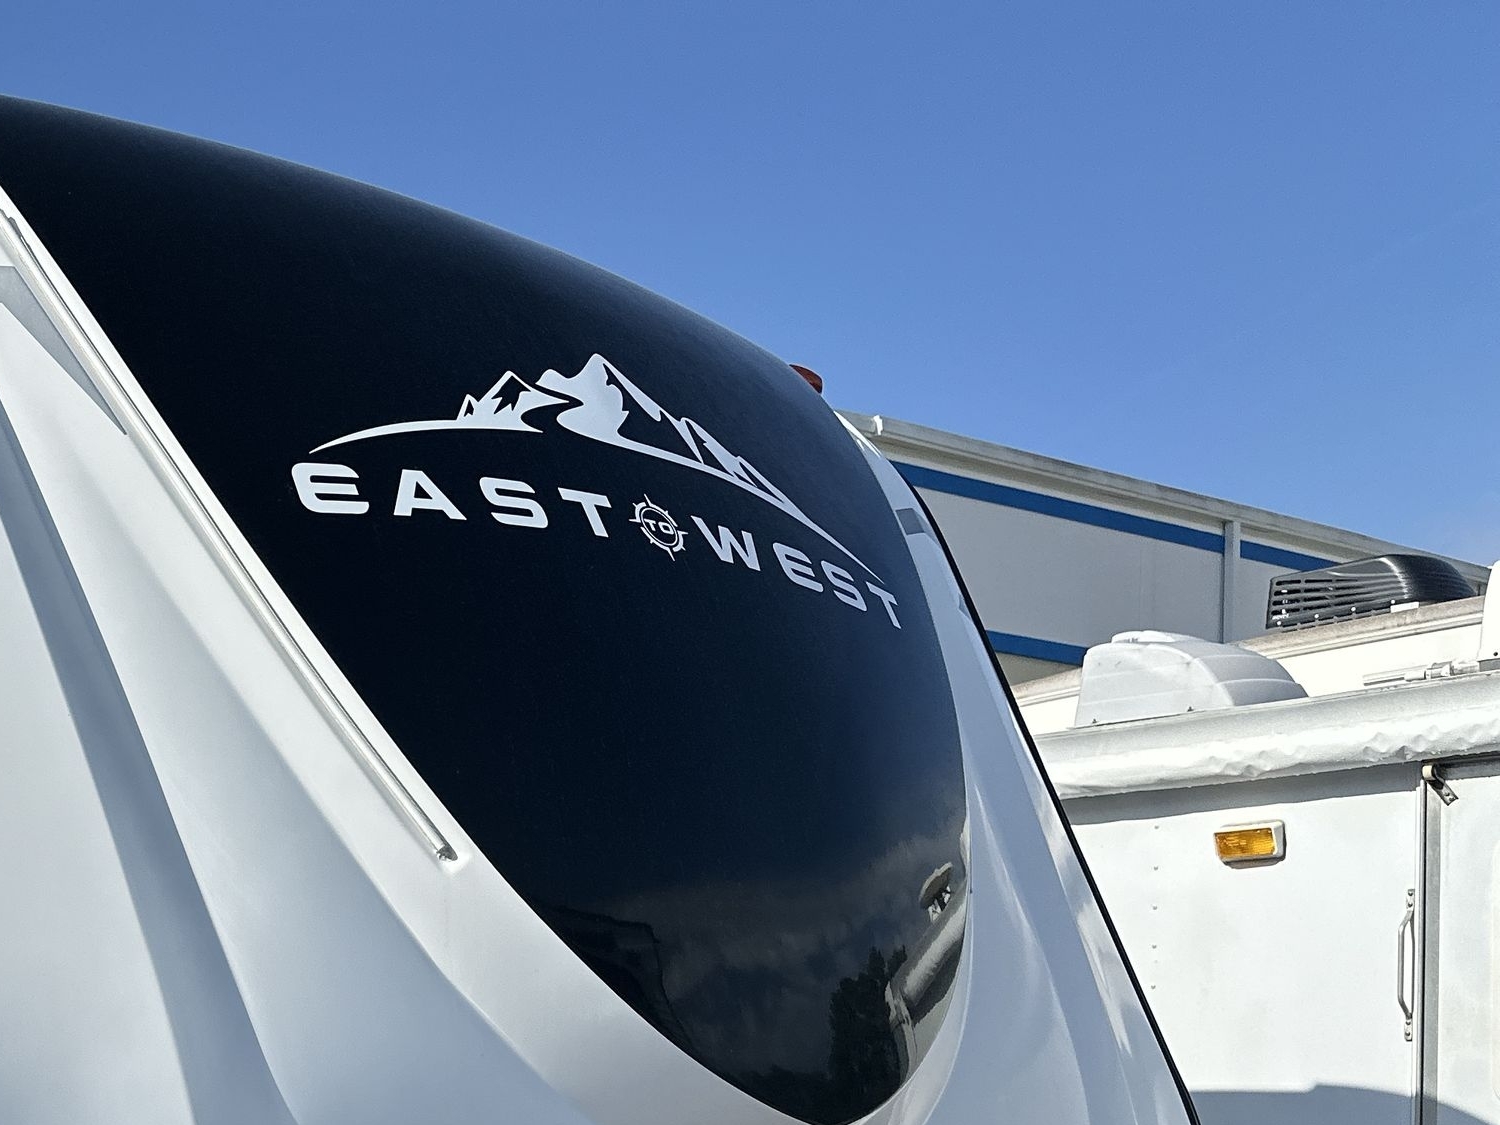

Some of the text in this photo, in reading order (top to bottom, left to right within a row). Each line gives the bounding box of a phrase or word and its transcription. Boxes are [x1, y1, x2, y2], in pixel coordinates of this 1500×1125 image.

[291, 462, 902, 630] EAST TO WEST
